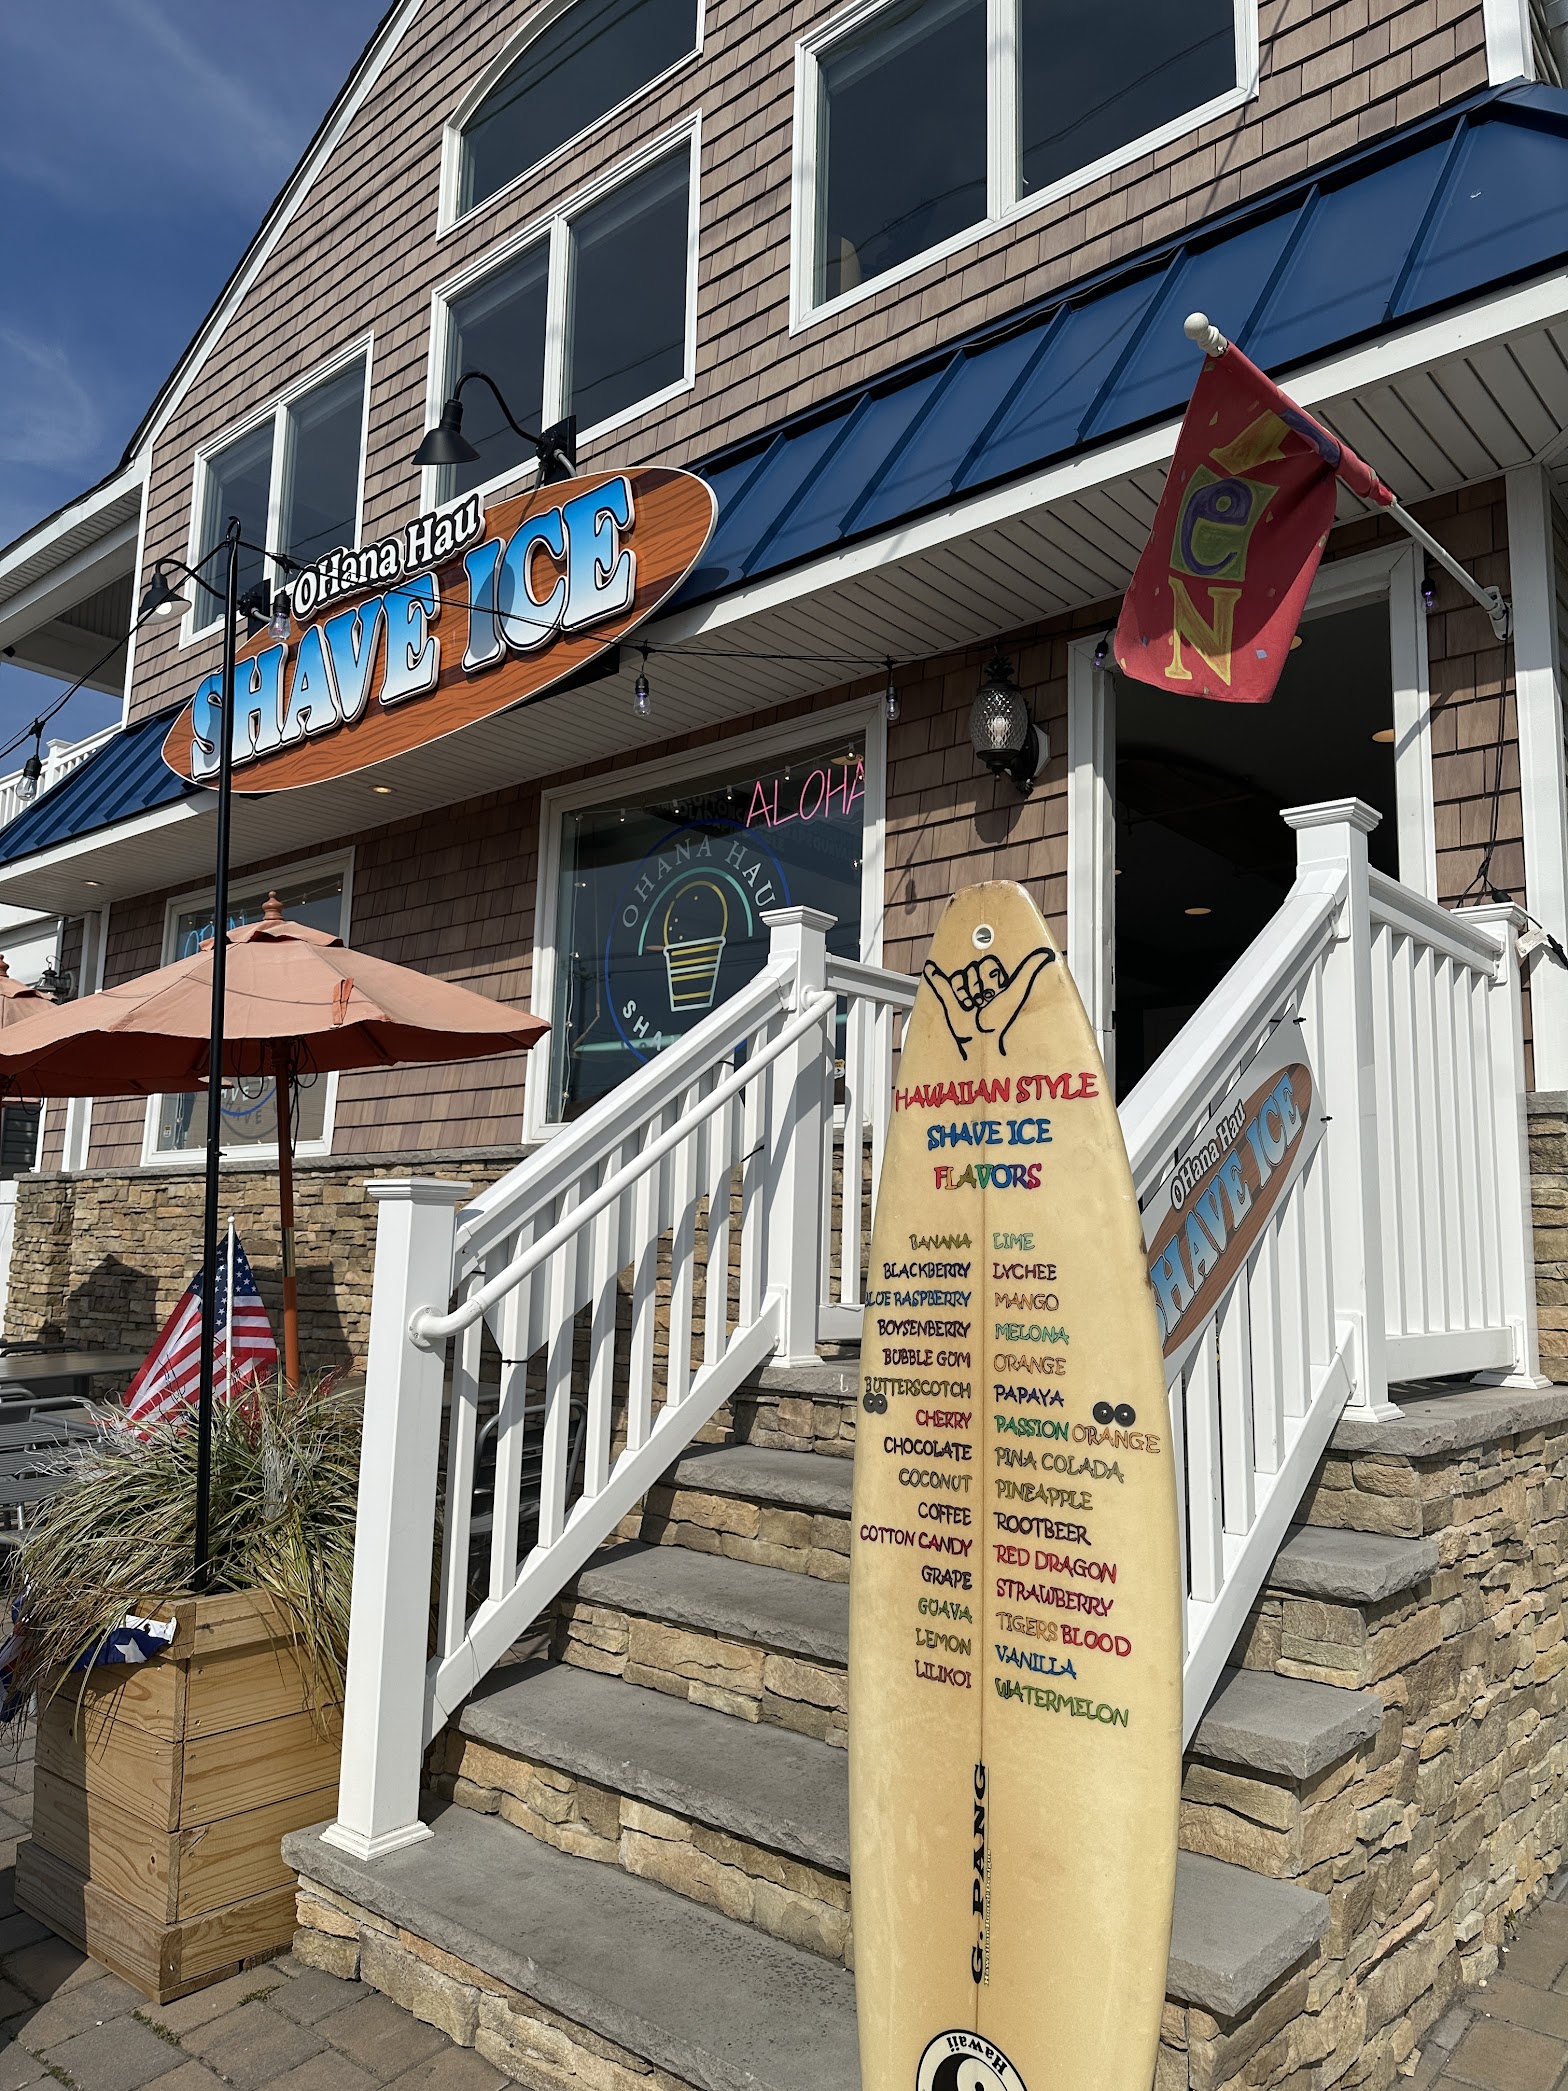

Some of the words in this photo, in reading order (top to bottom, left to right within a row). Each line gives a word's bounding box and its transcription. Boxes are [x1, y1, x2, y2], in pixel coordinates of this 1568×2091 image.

[405, 495, 480, 571] Hau
[190, 571, 441, 781] SHAVE
[461, 475, 636, 674] ICE
[622, 835, 713, 928] OHANA
[725, 841, 776, 908] HAU
[623, 1000, 662, 1051] SHA
[896, 1076, 1010, 1112] HAWAIIAN
[1016, 1072, 1099, 1103] STYLE
[928, 1121, 1004, 1151] SHAVE
[1008, 1118, 1053, 1146] ICE
[1216, 1099, 1246, 1152] Hau
[1245, 1072, 1302, 1189] ICE
[934, 1163, 1042, 1190] FLAVORS
[909, 1233, 972, 1250] BANANA
[993, 1232, 1035, 1250] LIME
[883, 1262, 971, 1280] BLACKBERRY
[993, 1263, 1057, 1281] LYCHEE
[893, 1290, 972, 1308] RASPBERRY
[994, 1293, 1059, 1311] MANGO
[877, 1319, 971, 1338] BOYSENBERRY
[995, 1323, 1070, 1345] MELONA
[882, 1348, 934, 1366] BUBBLE
[937, 1350, 971, 1368] GUM
[994, 1353, 1067, 1376] ORANGE
[864, 1376, 971, 1398] BUTTERSCOTCH
[994, 1384, 1065, 1408] PAPAYA
[916, 1409, 972, 1429] CHERRY
[994, 1414, 1069, 1442] PASSION
[1071, 1424, 1161, 1453] ORANGE
[884, 1436, 972, 1461] CHOCOLATE
[898, 1468, 973, 1493] COCONUT
[995, 1447, 1037, 1471] PINA
[1042, 1452, 1125, 1484] COLADA
[995, 1479, 1093, 1511] PINEAPPLE
[918, 1502, 972, 1526] COFFEE
[994, 1512, 1092, 1546] ROOTBEER
[860, 1525, 915, 1547] COTTON
[918, 1532, 973, 1557] CANDY
[921, 1565, 973, 1590] GRAPE
[994, 1544, 1030, 1568] RED
[1035, 1550, 1118, 1584] DRAGON
[918, 1598, 973, 1624] GUAVA
[996, 1579, 1114, 1617] STRAWBERRY
[916, 1628, 972, 1656] LEMON
[996, 1612, 1058, 1642] TIGERS
[1060, 1624, 1132, 1657] BLOOD
[915, 1659, 972, 1689] LILIKOI
[995, 1645, 1077, 1680] VANILLA
[995, 1678, 1128, 1727] WATERMELON
[972, 1760, 986, 1919] PANG
[971, 1929, 985, 1984] G.
[946, 2035, 1007, 2075] Hawaii
